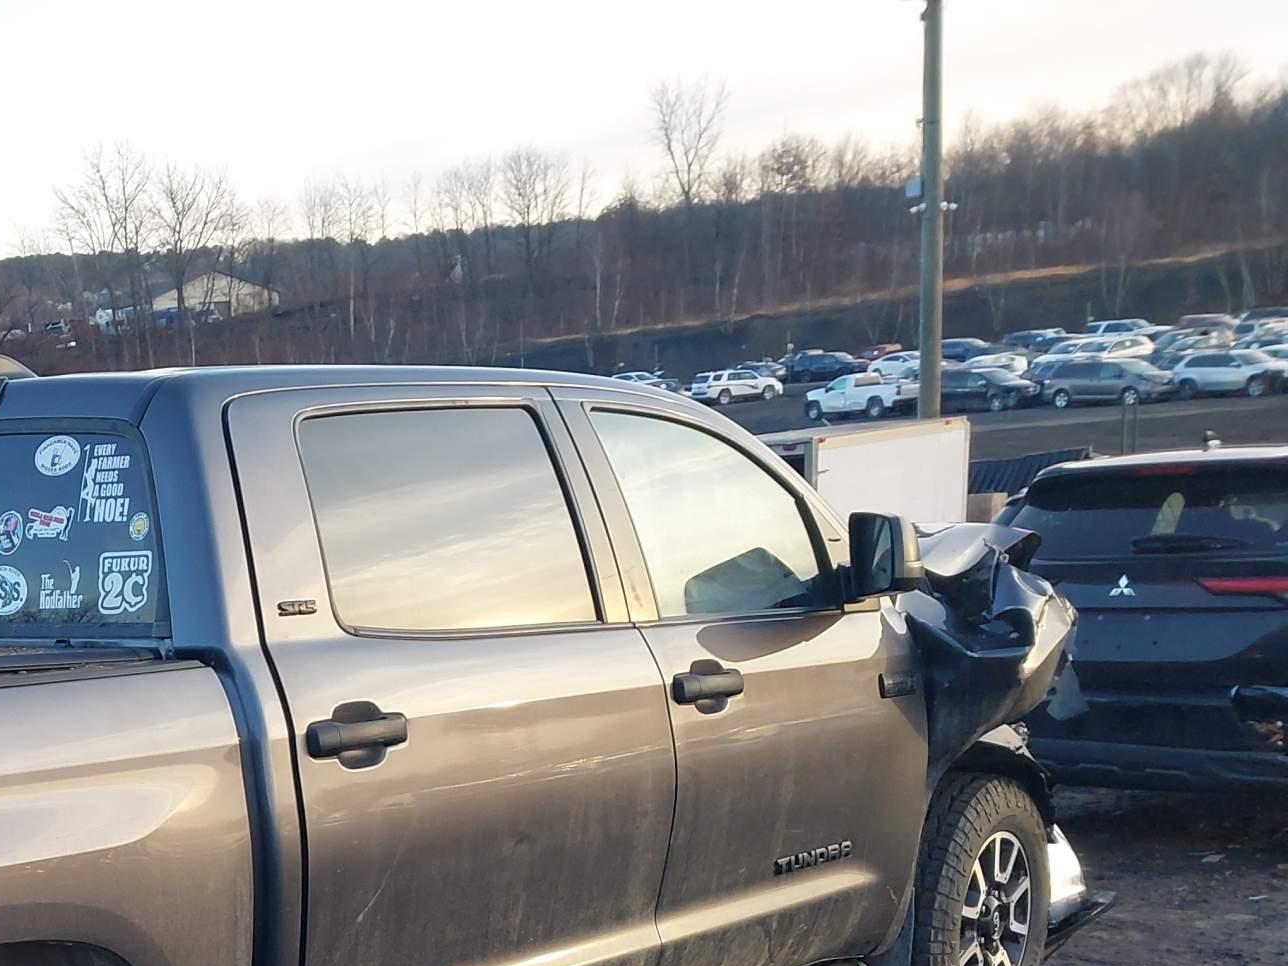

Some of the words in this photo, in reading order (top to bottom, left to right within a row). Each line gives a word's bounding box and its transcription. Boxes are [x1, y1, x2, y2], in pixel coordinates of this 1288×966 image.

[93, 443, 117, 457] EVERY
[98, 455, 130, 470] FARMER
[95, 470, 119, 483] NEEDS
[93, 484, 99, 497] A
[100, 483, 124, 497] GOOD
[94, 498, 130, 523] HOE!
[103, 556, 148, 573] FUKUR
[41, 573, 54, 589] The
[39, 589, 83, 609] Rodfather
[775, 840, 853, 875] TUNDRA
